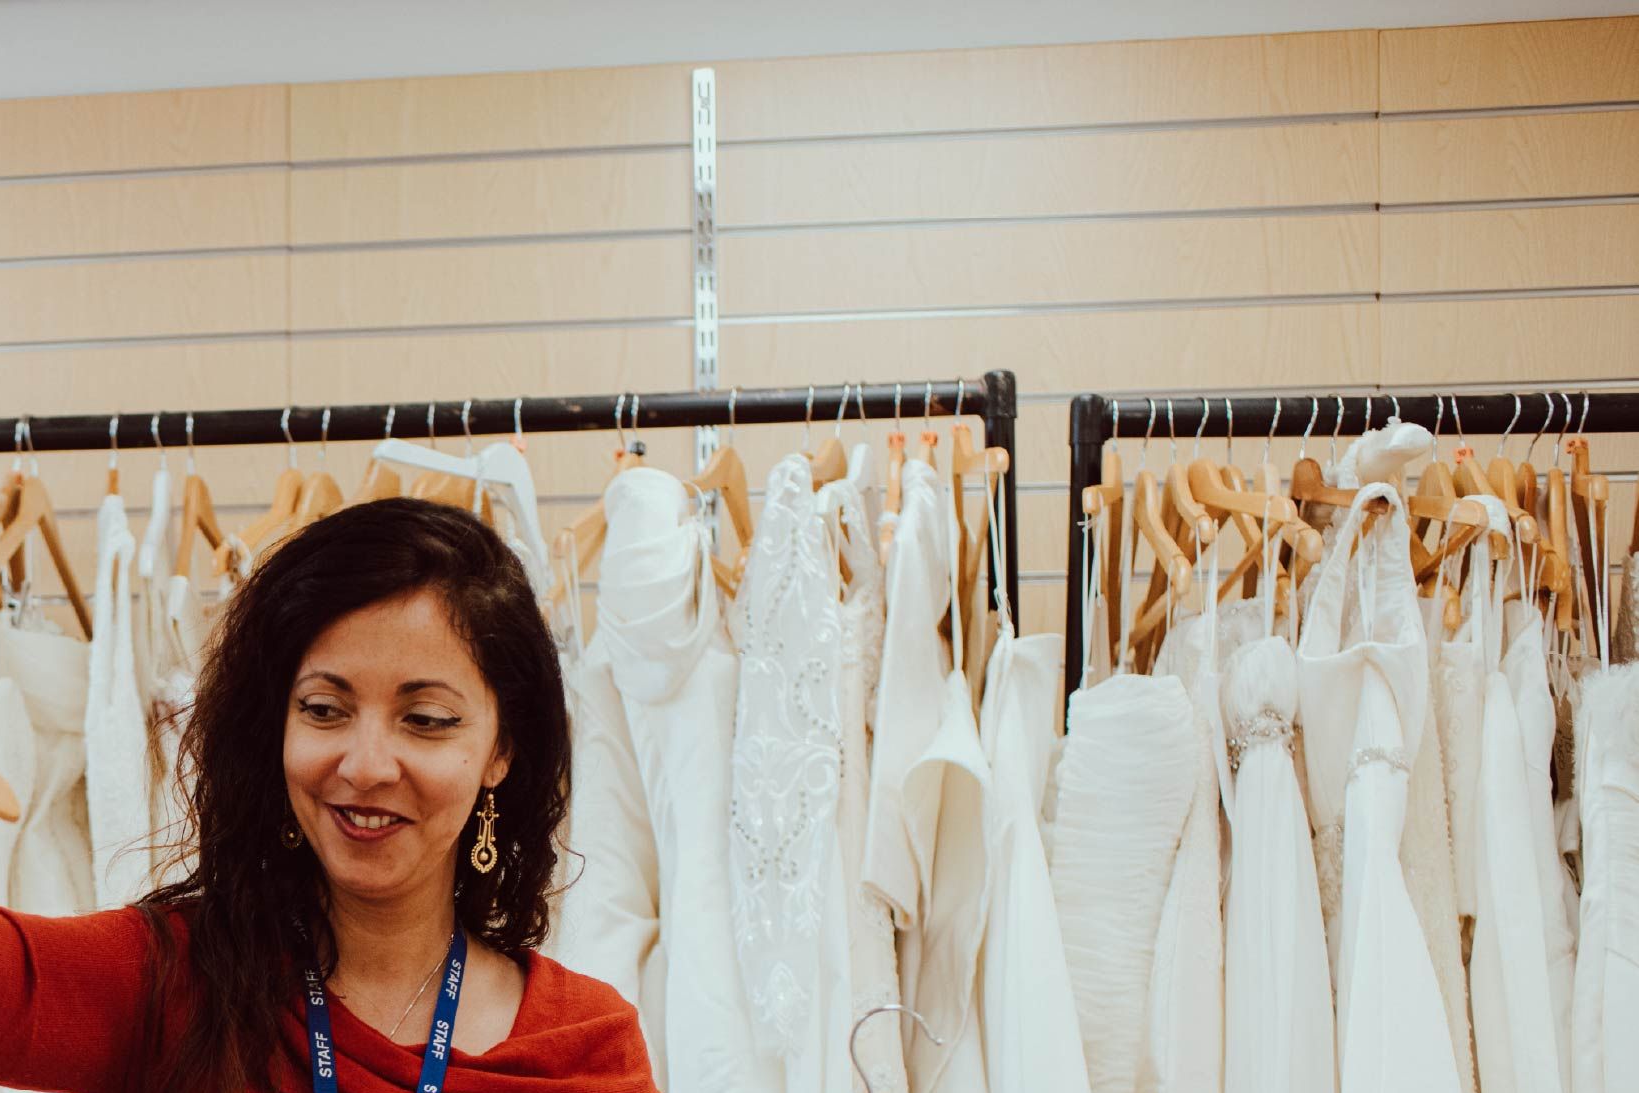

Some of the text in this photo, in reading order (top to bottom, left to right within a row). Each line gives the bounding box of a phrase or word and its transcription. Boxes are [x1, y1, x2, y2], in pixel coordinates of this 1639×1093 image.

[446, 959, 461, 1000] STAFF
[315, 1032, 332, 1078] STAFF
[431, 1020, 449, 1060] STAFF
